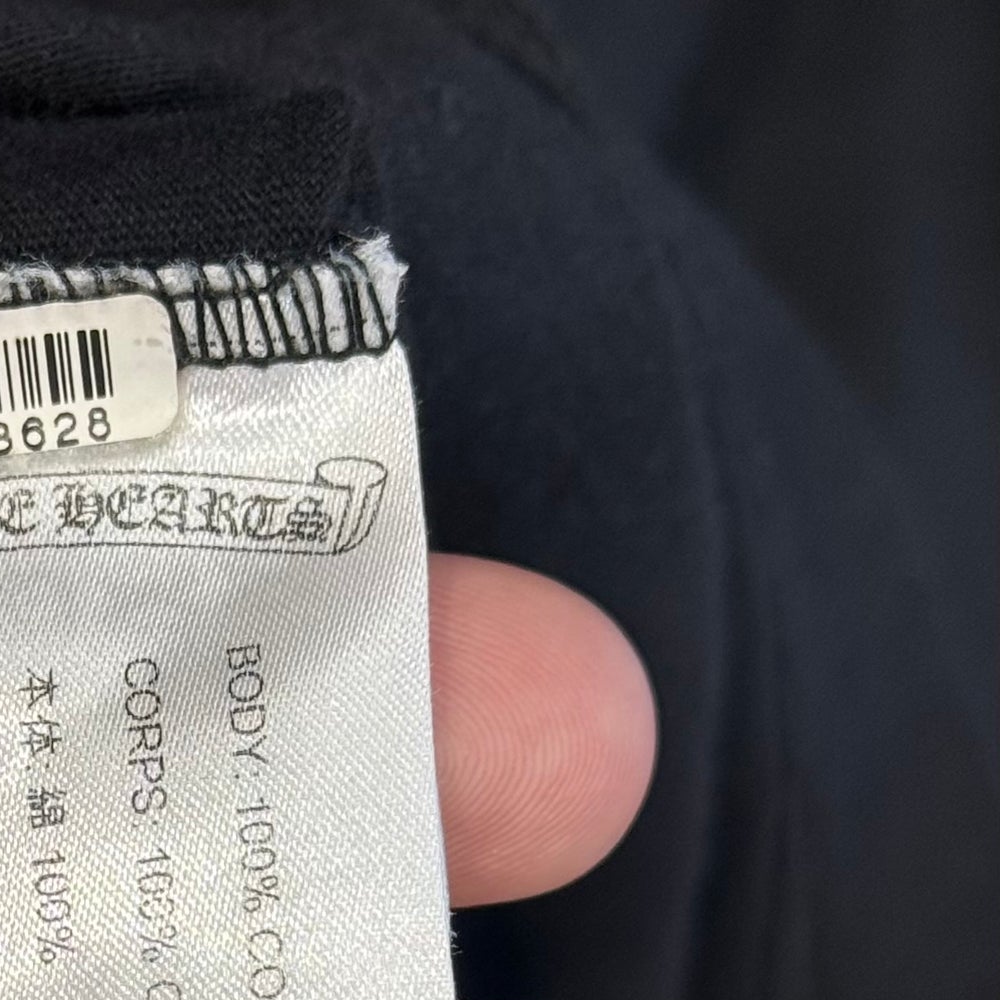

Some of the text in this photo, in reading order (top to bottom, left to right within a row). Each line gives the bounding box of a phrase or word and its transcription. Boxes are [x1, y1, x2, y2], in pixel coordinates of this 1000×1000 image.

[56, 482, 334, 546] HEARTS
[124, 657, 168, 828] CORPS:
[226, 643, 269, 779] BODY:
[32, 850, 75, 964] 100%
[136, 847, 178, 963] 100%
[236, 797, 281, 913] 100%
